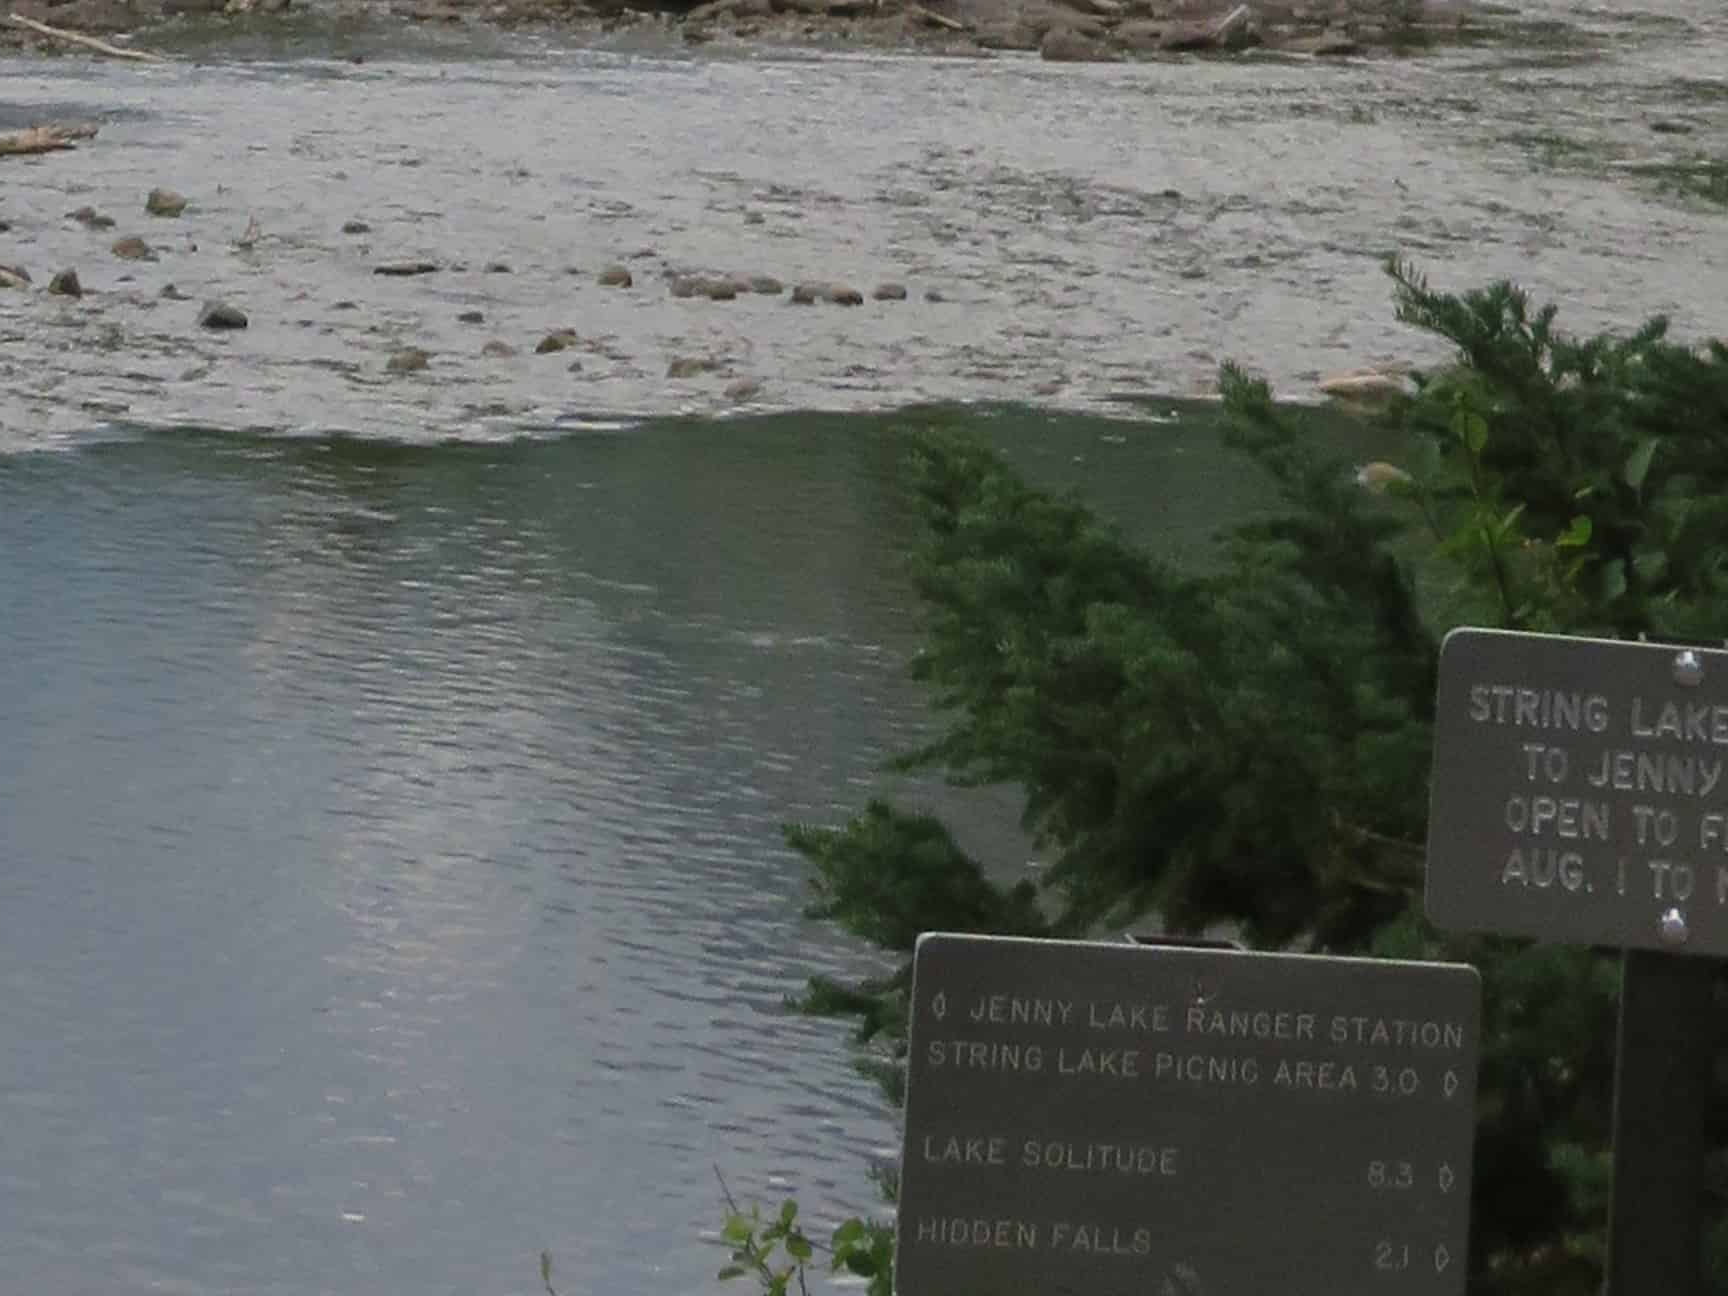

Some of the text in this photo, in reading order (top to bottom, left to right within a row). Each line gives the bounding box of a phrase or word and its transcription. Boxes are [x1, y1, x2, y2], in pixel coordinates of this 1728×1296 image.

[1469, 684, 1609, 732] STRING
[1522, 743, 1568, 783] TO
[1588, 749, 1722, 797] JENNY
[1504, 796, 1609, 840] OPEN
[1632, 804, 1678, 846] TO
[1502, 848, 1593, 892] AUG.
[1648, 860, 1695, 901] TO
[969, 993, 1464, 1048] JENNY LAKE RANGER STATION
[927, 1040, 1419, 1095] STRING LAKE PICNIC AREA 3.0
[922, 1136, 1006, 1164] LAKE
[1022, 1140, 1180, 1175] SOLITUDE
[916, 1216, 1037, 1248] HIDDEN
[1050, 1222, 1151, 1256] FALLS
